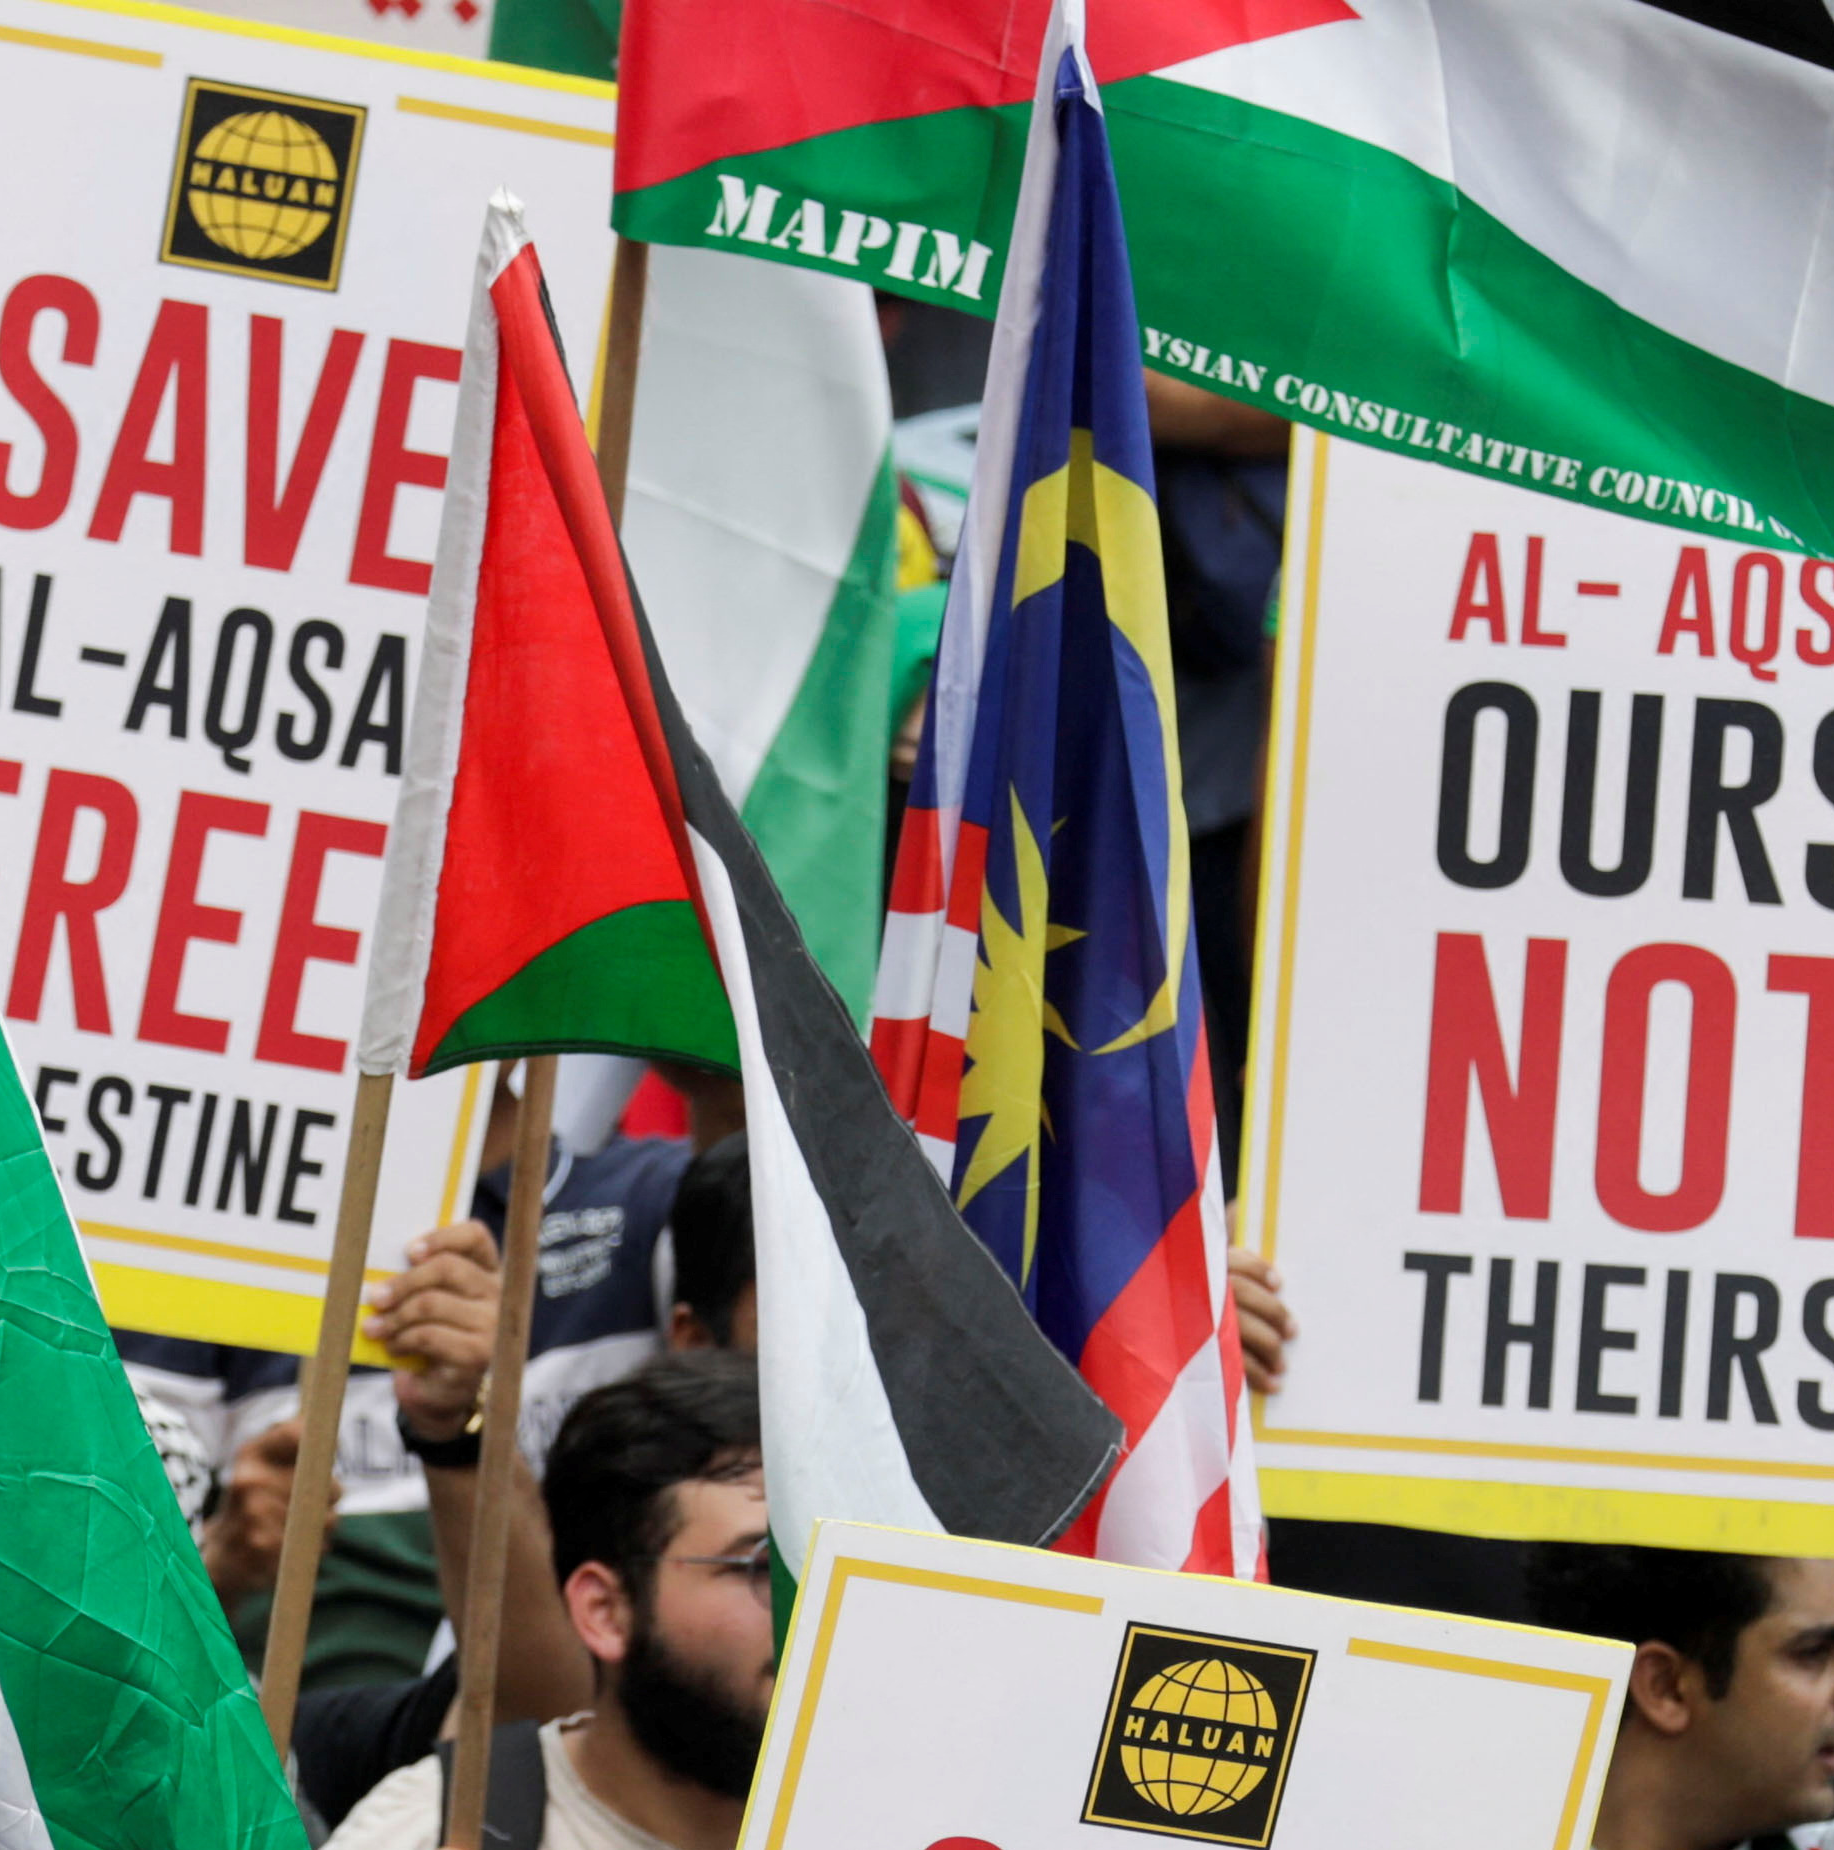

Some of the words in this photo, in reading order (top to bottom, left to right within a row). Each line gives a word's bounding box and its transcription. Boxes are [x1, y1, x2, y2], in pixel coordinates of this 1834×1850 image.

[190, 160, 338, 208] HALUAN
[704, 172, 994, 301] MAPIM
[1143, 327, 1268, 391] YSIAN
[1273, 373, 1582, 492] CONSULTATIVE
[1588, 463, 1765, 534] COUNCIL
[34, 1065, 337, 1226] ESTINE
[1123, 1713, 1276, 1761] HALUAN
